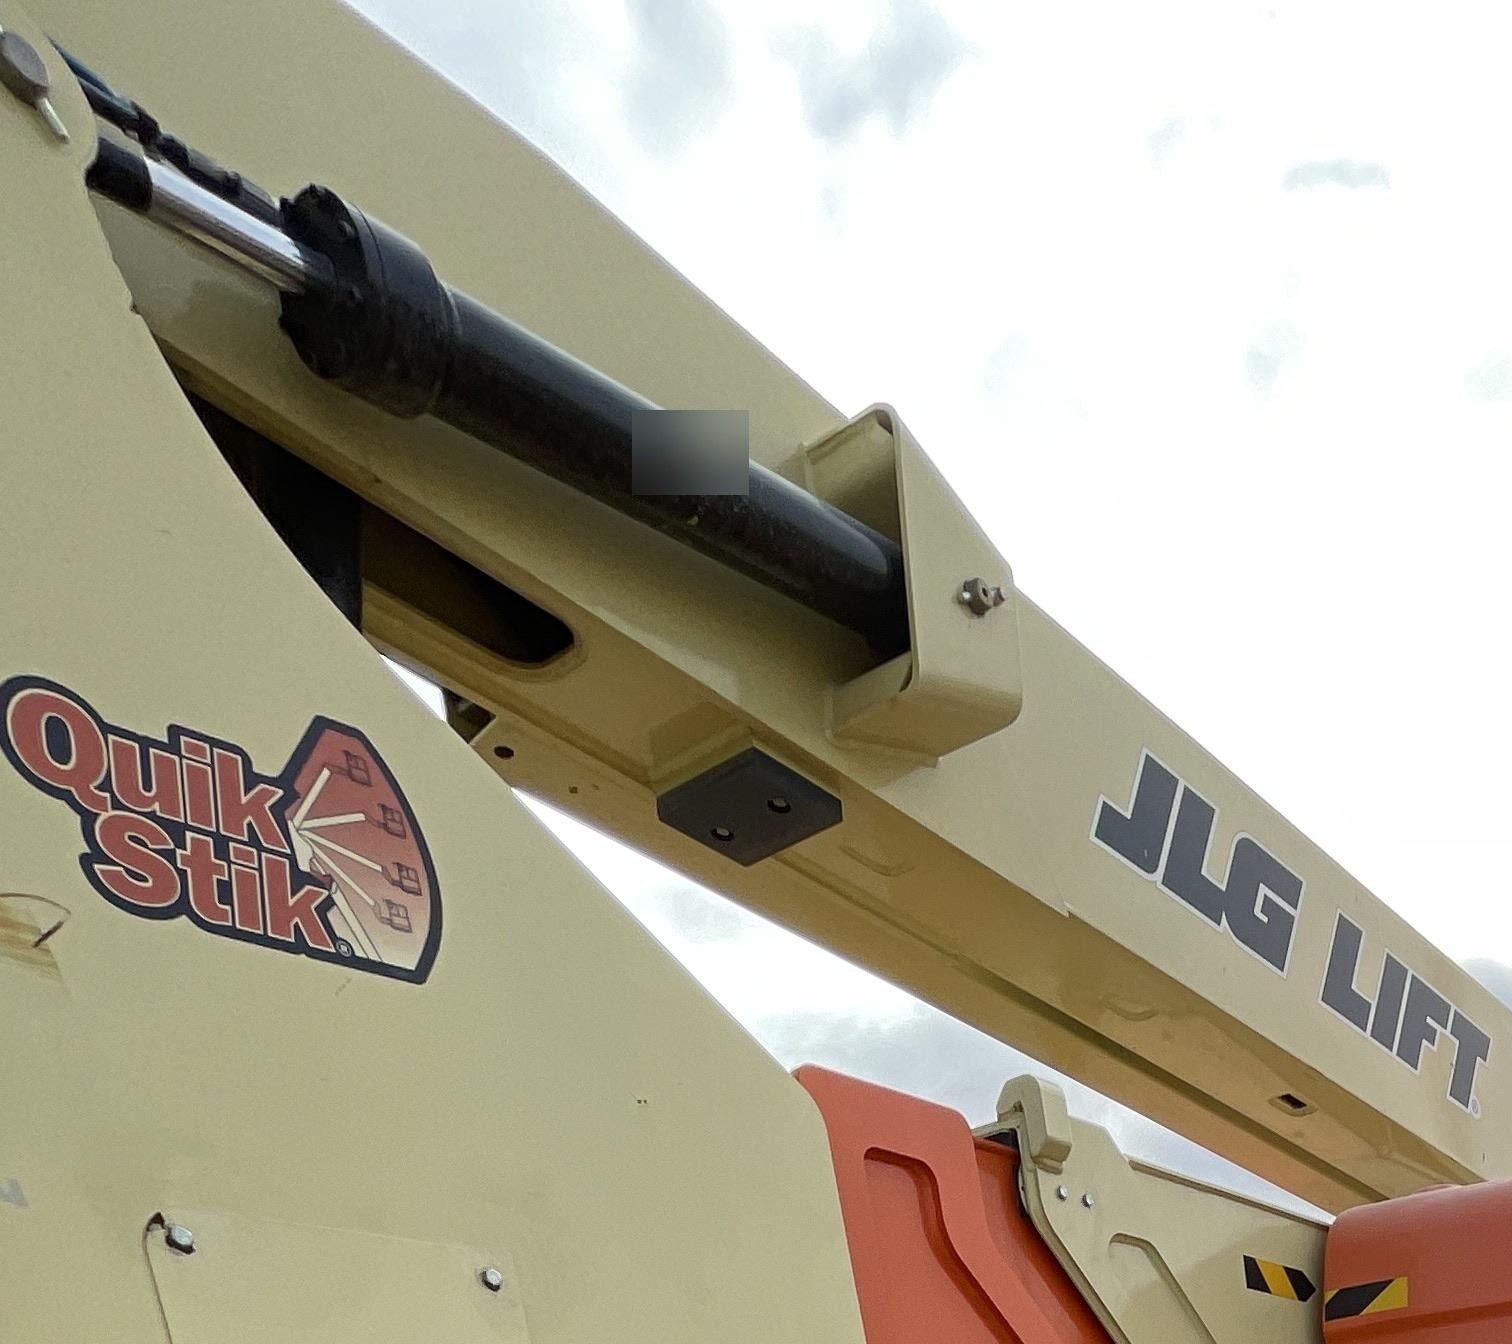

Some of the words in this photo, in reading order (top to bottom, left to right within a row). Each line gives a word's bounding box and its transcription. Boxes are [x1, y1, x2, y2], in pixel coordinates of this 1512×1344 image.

[5, 687, 292, 853] Quik
[94, 812, 334, 953] Stik
[1089, 747, 1306, 978] JLG
[1319, 909, 1493, 1115] LIFT
